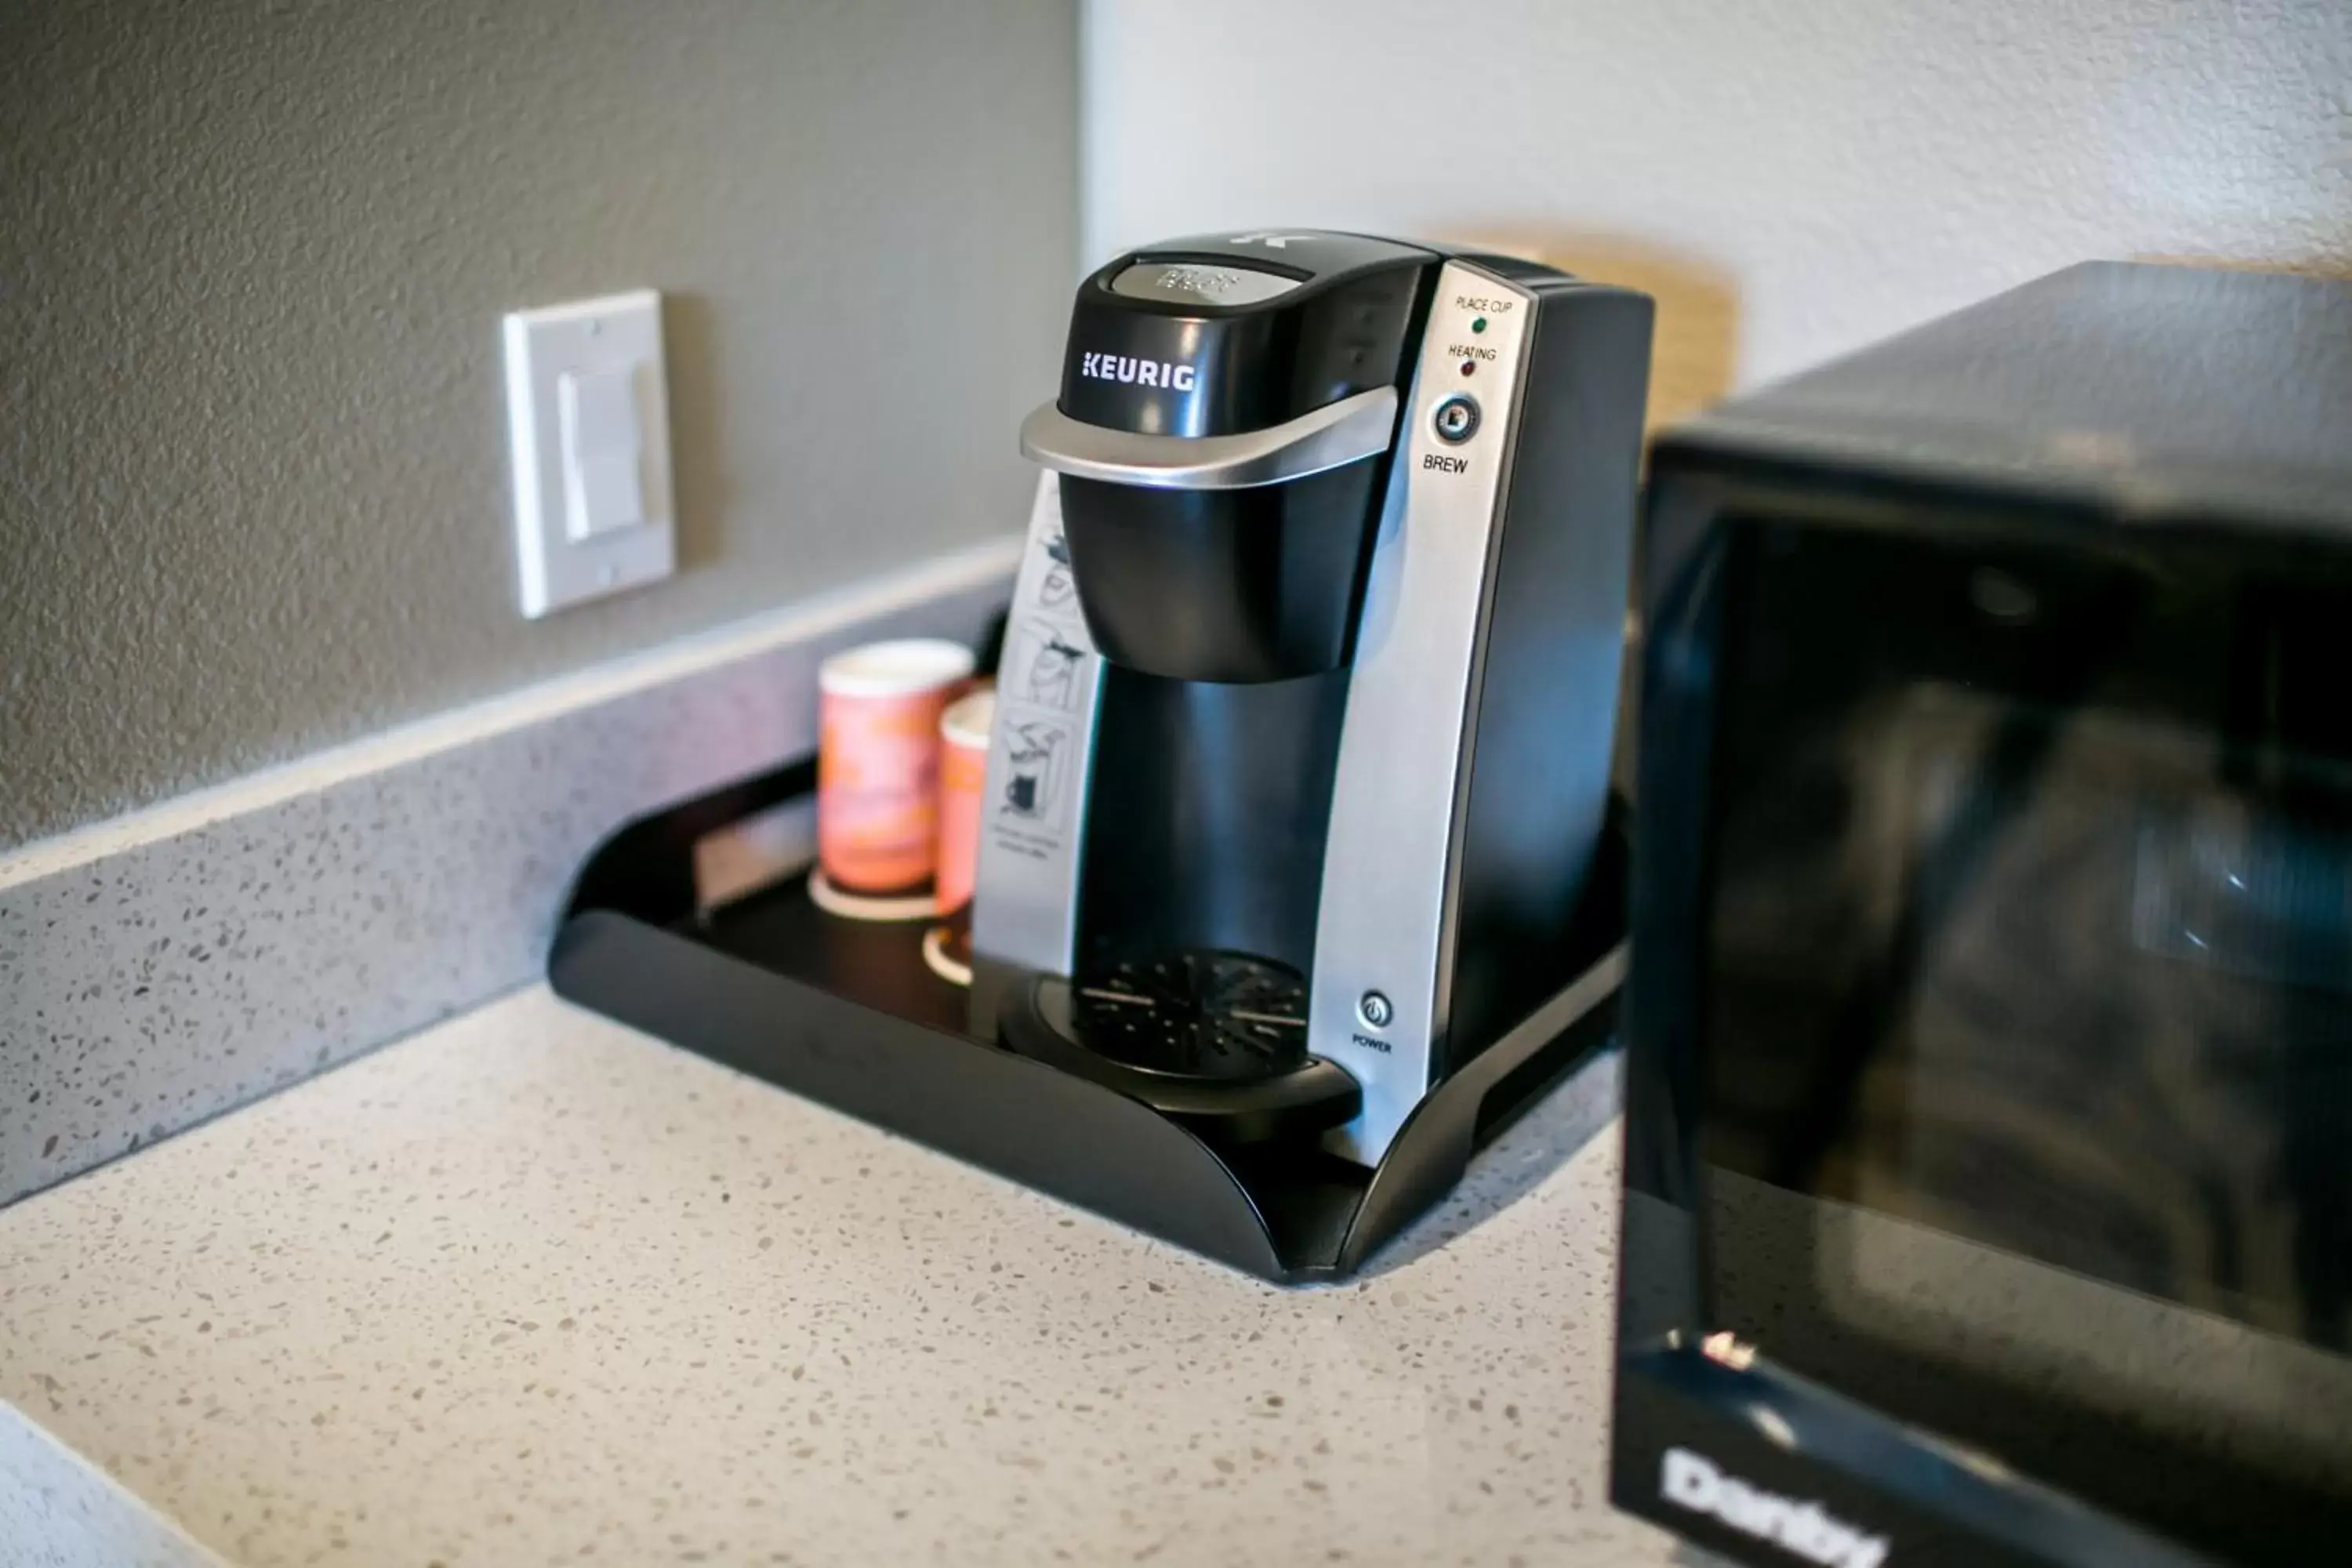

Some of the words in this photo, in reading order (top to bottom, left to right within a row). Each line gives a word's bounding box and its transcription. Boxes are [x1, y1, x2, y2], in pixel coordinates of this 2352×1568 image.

[1455, 296, 1489, 310] PLACE
[1490, 301, 1512, 313] CUP
[1449, 345, 1497, 360] HEATING
[1083, 352, 1194, 390] KEURIG
[1423, 454, 1468, 474] BREW
[1353, 1034, 1392, 1053] POWER
